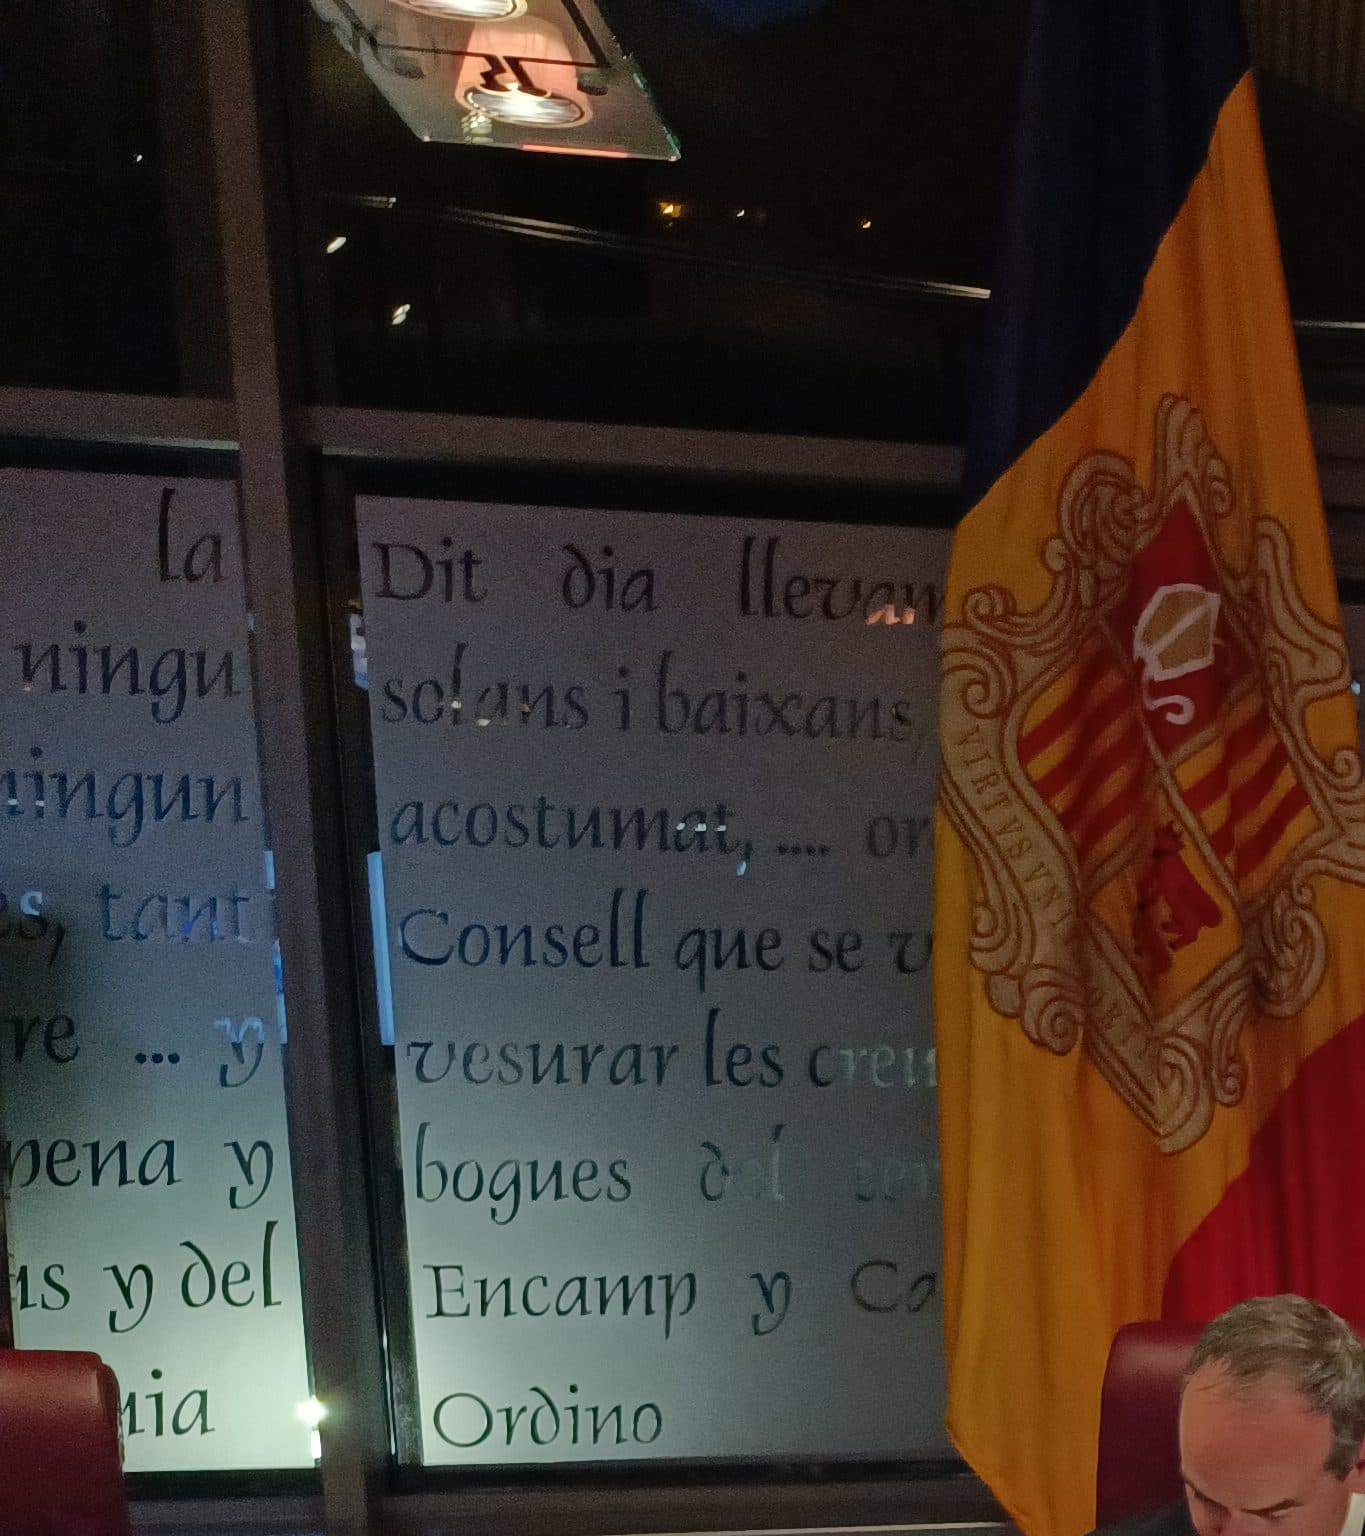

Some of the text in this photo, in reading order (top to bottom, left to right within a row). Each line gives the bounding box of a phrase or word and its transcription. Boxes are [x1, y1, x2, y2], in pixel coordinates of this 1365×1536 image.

[157, 487, 226, 583] la
[372, 536, 488, 604] Dit
[562, 545, 660, 612] dia
[14, 618, 242, 724] ningu
[382, 642, 590, 729] solans
[615, 666, 634, 733] i
[399, 888, 651, 970] Consell
[673, 922, 783, 993] que
[807, 928, 863, 973] se
[2, 1014, 80, 1064] re
[213, 1015, 264, 1089] y
[703, 1008, 786, 1088] les
[223, 1140, 274, 1209] y
[414, 1121, 633, 1227] bogues
[103, 1263, 154, 1333] y
[179, 1220, 283, 1308] del
[422, 1264, 793, 1340] Encamp y
[433, 1384, 663, 1449] Ordino
